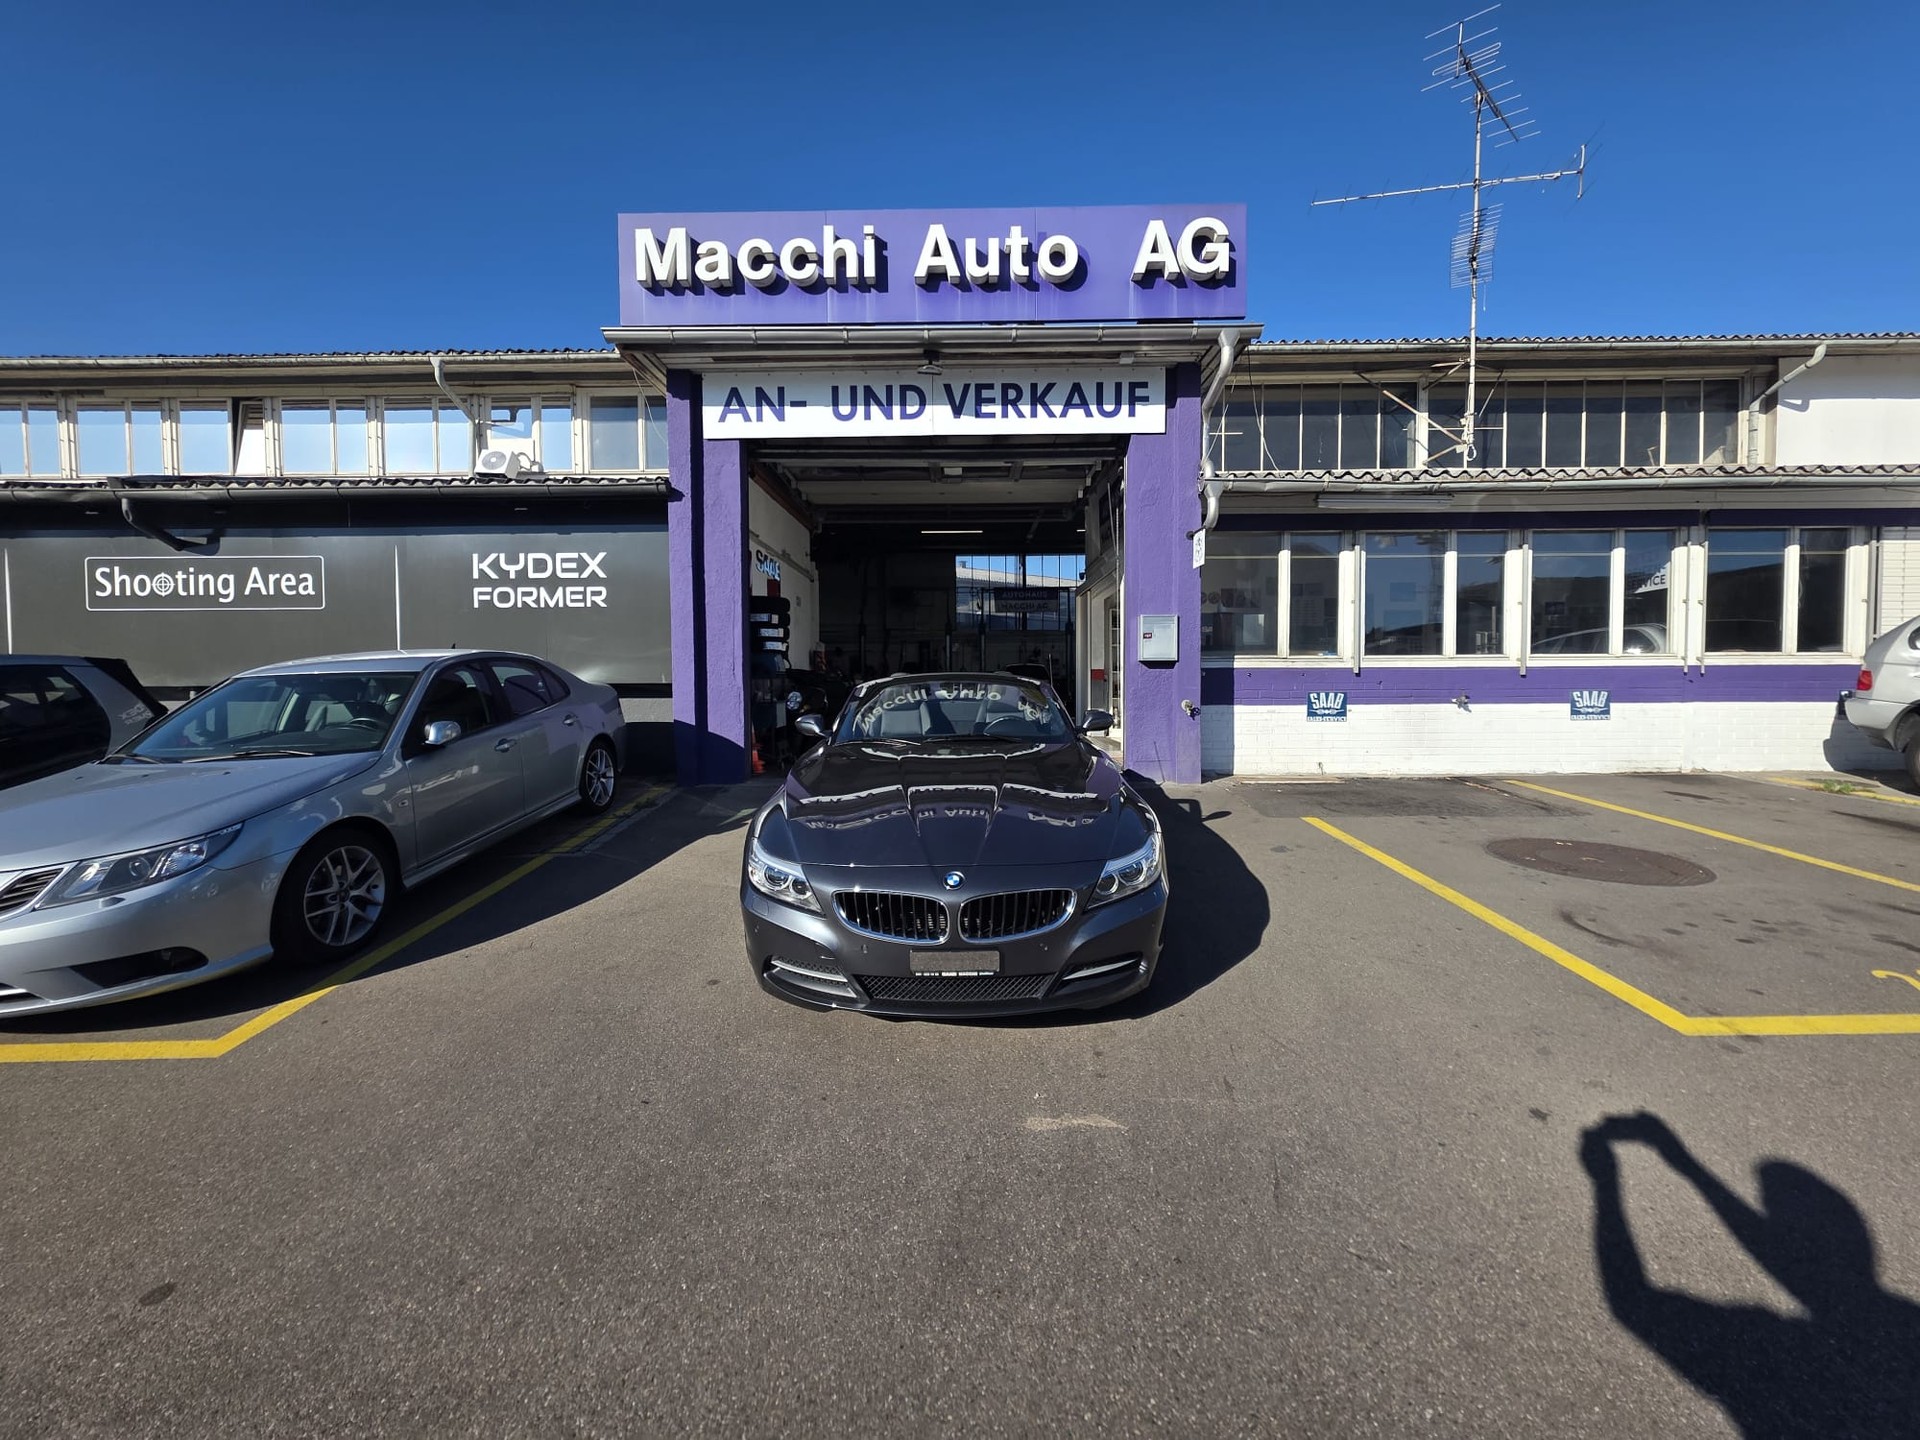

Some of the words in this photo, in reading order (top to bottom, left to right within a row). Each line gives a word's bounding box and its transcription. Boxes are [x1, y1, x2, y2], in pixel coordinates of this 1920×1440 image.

[634, 224, 877, 288] Macchi
[913, 223, 1079, 284] Auto
[1130, 216, 1230, 282] AG
[718, 385, 808, 423] AN-
[831, 384, 927, 421] UND
[943, 381, 1151, 420] VERKAUF
[472, 551, 608, 579] KYDEX
[244, 566, 316, 596] Area
[473, 586, 608, 609] FORMER
[1309, 692, 1345, 709] SAAB
[1572, 690, 1608, 707] SAAB
